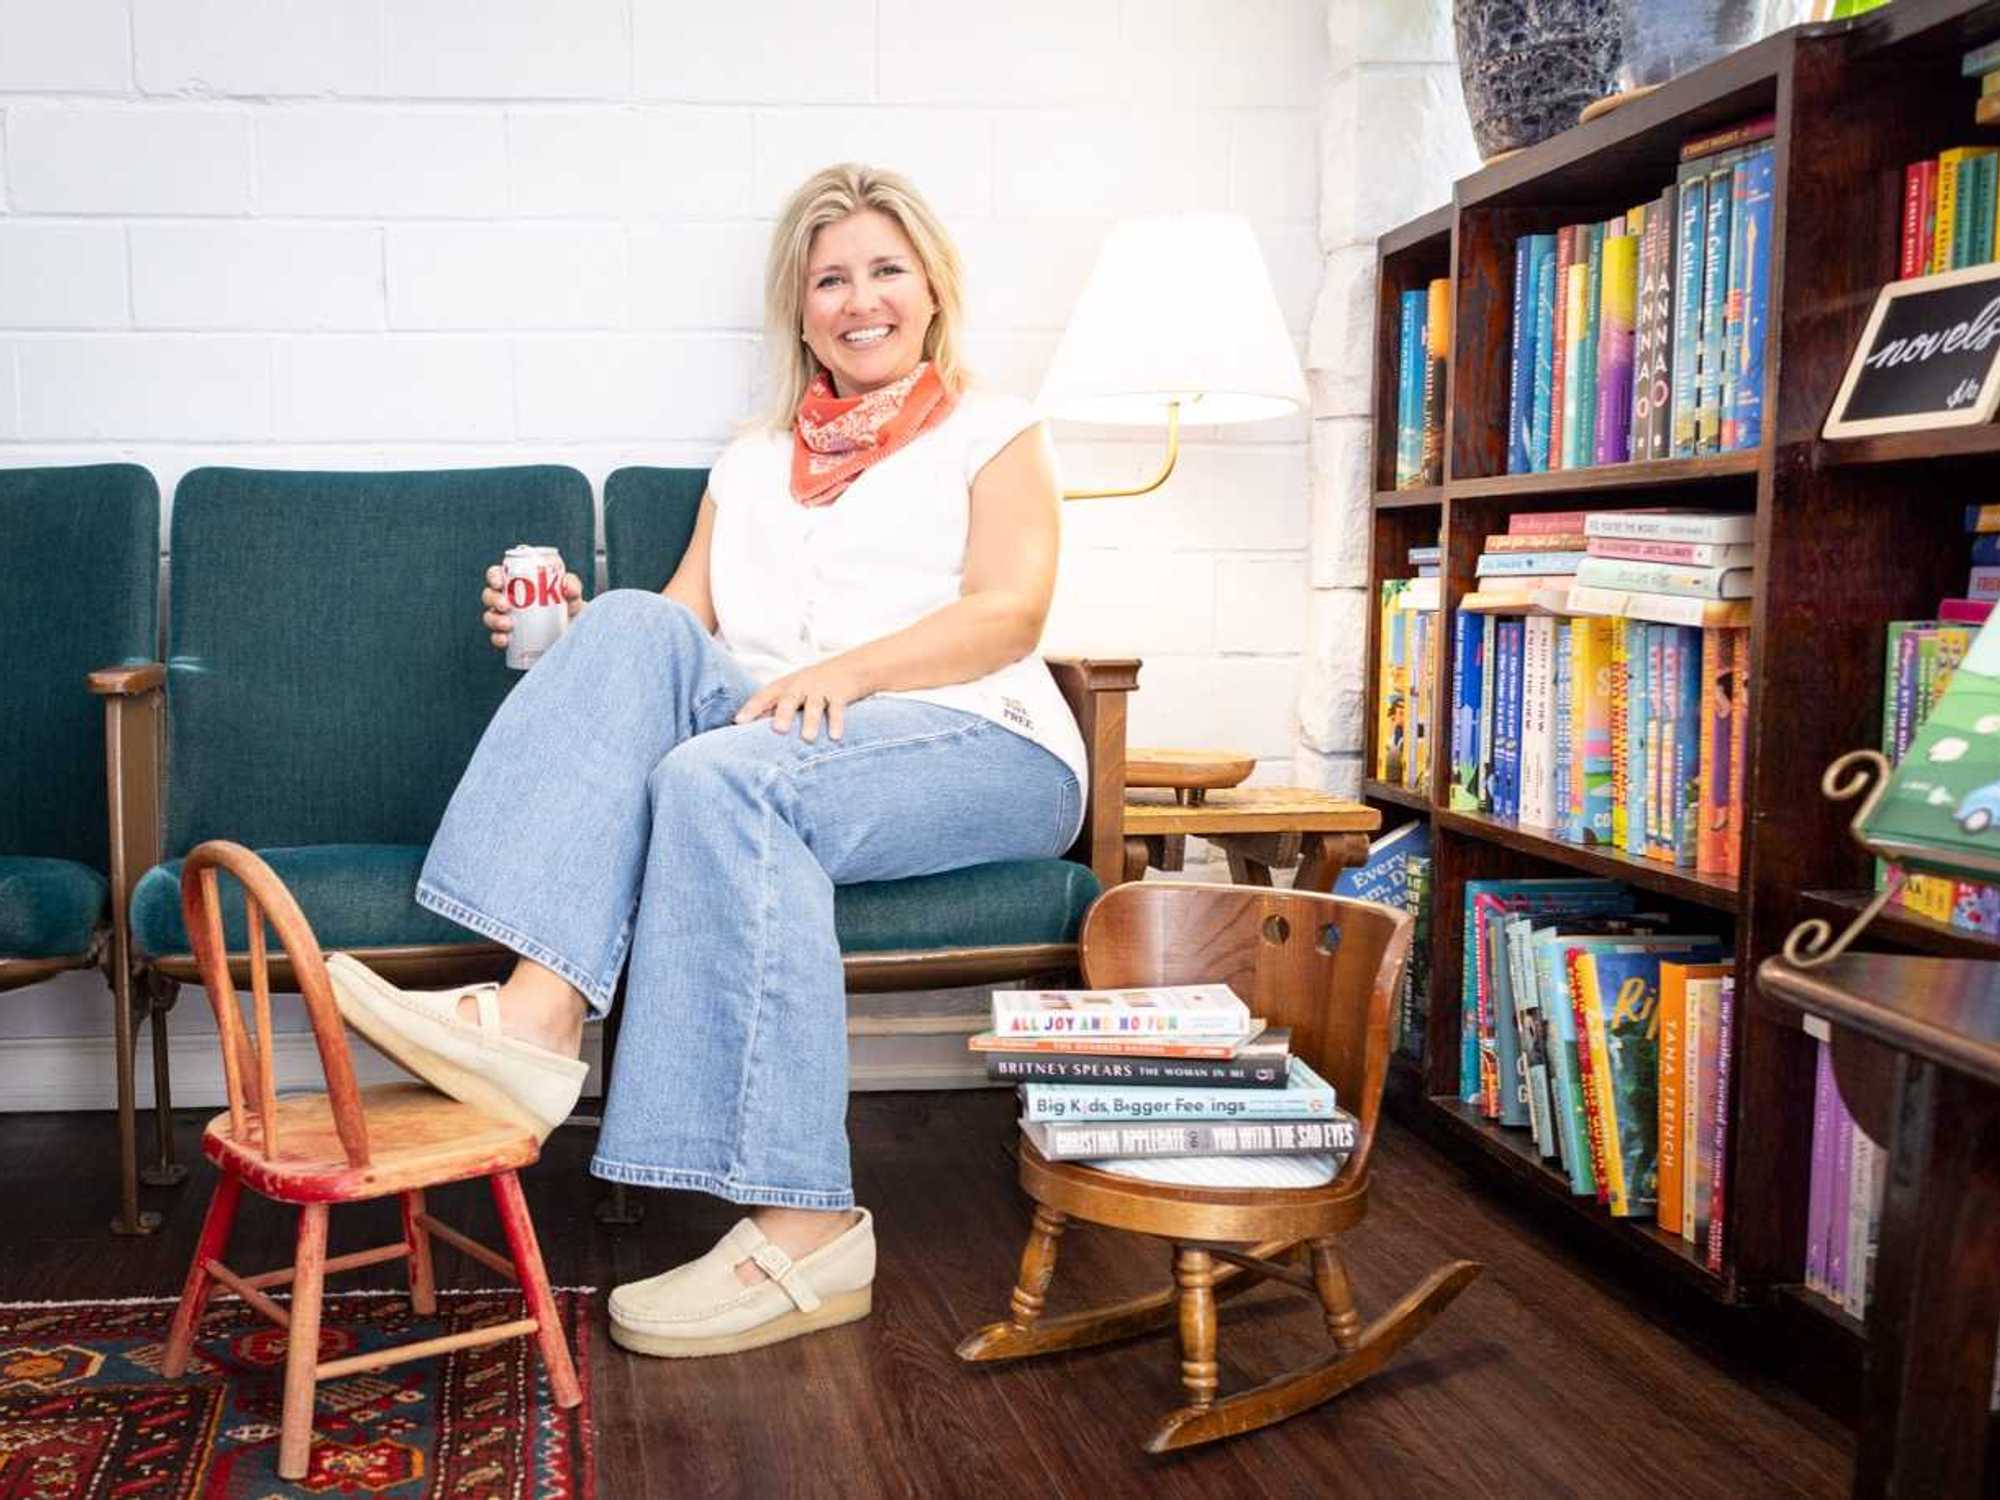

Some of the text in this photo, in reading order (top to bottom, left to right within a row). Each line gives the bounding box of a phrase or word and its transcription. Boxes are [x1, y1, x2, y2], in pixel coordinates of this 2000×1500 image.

[1654, 272, 1670, 373] ANNA
[1011, 1017, 1039, 1031] ALL
[1044, 1017, 1074, 1031] JOY
[1119, 1017, 1140, 1031] NO
[1718, 1025, 1732, 1075] mother
[998, 1062, 1068, 1076] BRITNEY
[1072, 1063, 1133, 1077] SPEARS
[1138, 1067, 1160, 1076] THE
[1164, 1068, 1208, 1078] WOMAN
[1212, 1069, 1225, 1078] IN
[1662, 1019, 1678, 1168] TANA FRENCH
[1036, 1098, 1065, 1116] Big
[1113, 1098, 1170, 1116] Bigger
[1175, 1098, 1246, 1116] Feeings
[1213, 1127, 1237, 1149] YOU
[1239, 1126, 1272, 1149] WITH
[1273, 1125, 1296, 1148] THE
[1298, 1124, 1323, 1148] SAD
[1324, 1123, 1354, 1148] EYES
